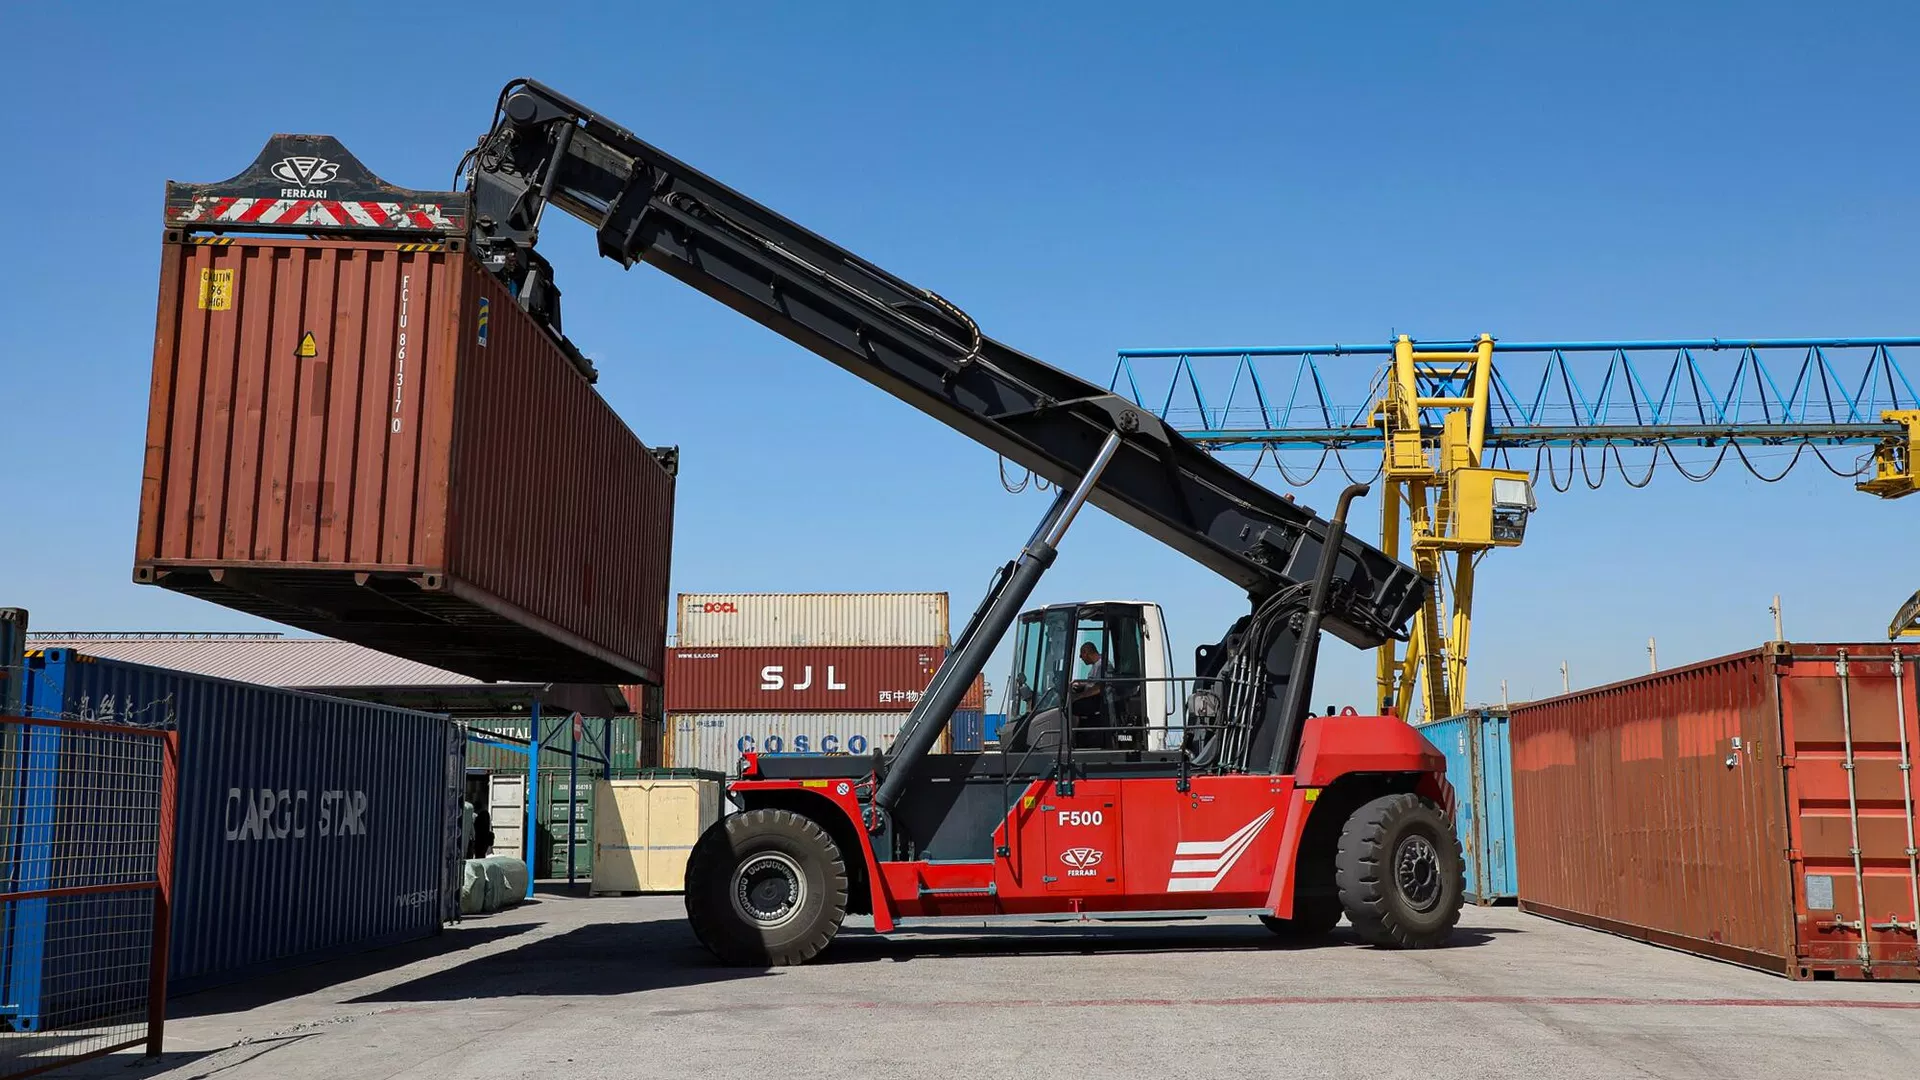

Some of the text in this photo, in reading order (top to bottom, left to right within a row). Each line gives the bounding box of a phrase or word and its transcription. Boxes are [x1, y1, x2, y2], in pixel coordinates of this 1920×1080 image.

[271, 156, 340, 188] CVS
[281, 189, 327, 198] FERRARI
[400, 275, 410, 328] FCIU
[395, 333, 406, 413] 861317
[737, 735, 867, 755] COSCO
[318, 789, 367, 837] STAR
[1058, 811, 1103, 826] F500
[1060, 848, 1103, 869] CVS
